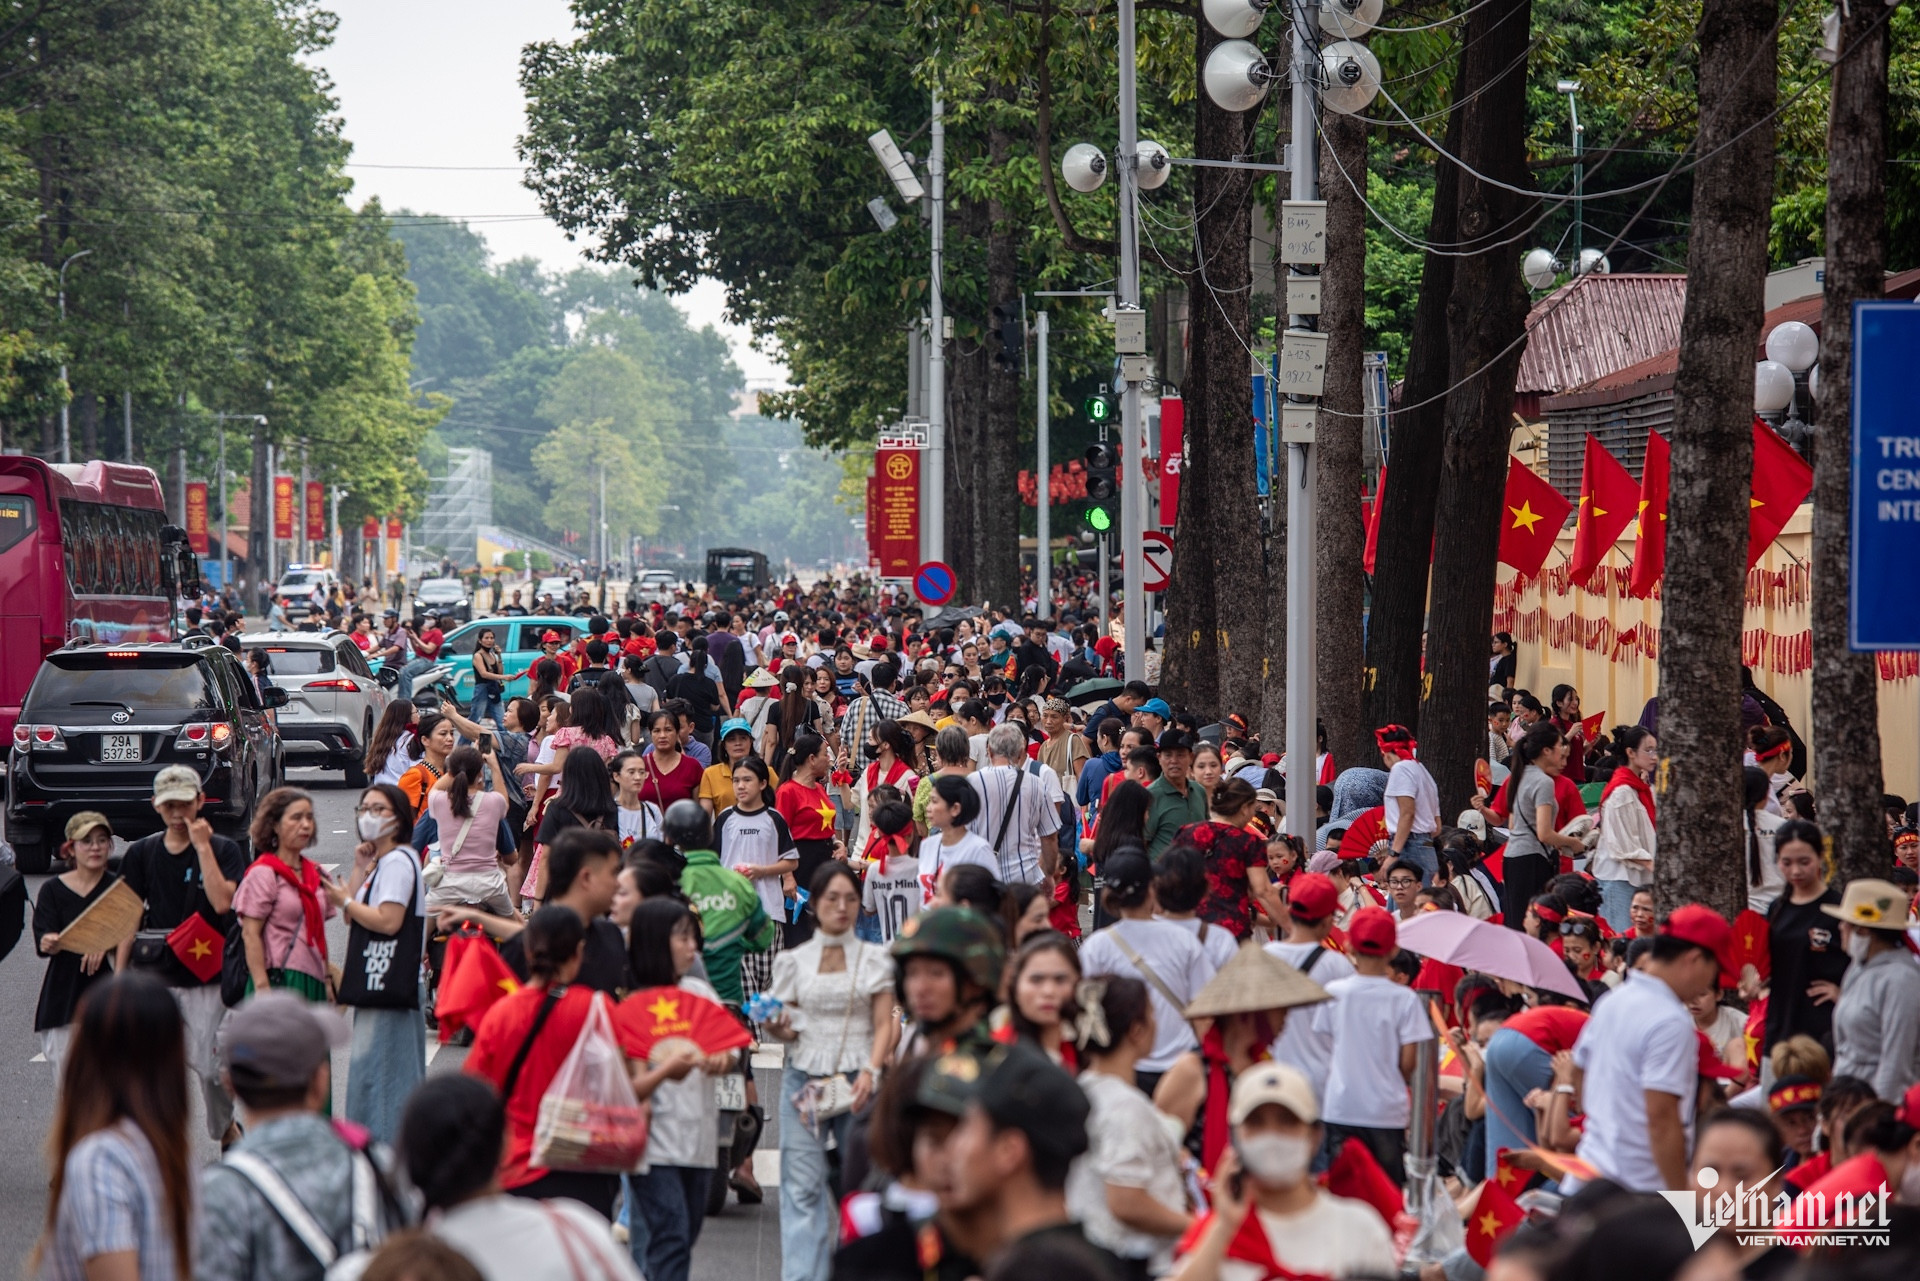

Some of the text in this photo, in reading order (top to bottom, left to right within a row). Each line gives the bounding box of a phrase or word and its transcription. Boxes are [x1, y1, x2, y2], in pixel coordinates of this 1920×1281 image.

[1093, 401, 1104, 417] 0
[111, 735, 131, 747] 29A
[103, 747, 139, 760] 537.85
[739, 828, 761, 836] TEDDY
[894, 879, 920, 889] Minh
[362, 939, 398, 958] JUST
[365, 957, 391, 974] DO
[367, 973, 385, 991] IT.
